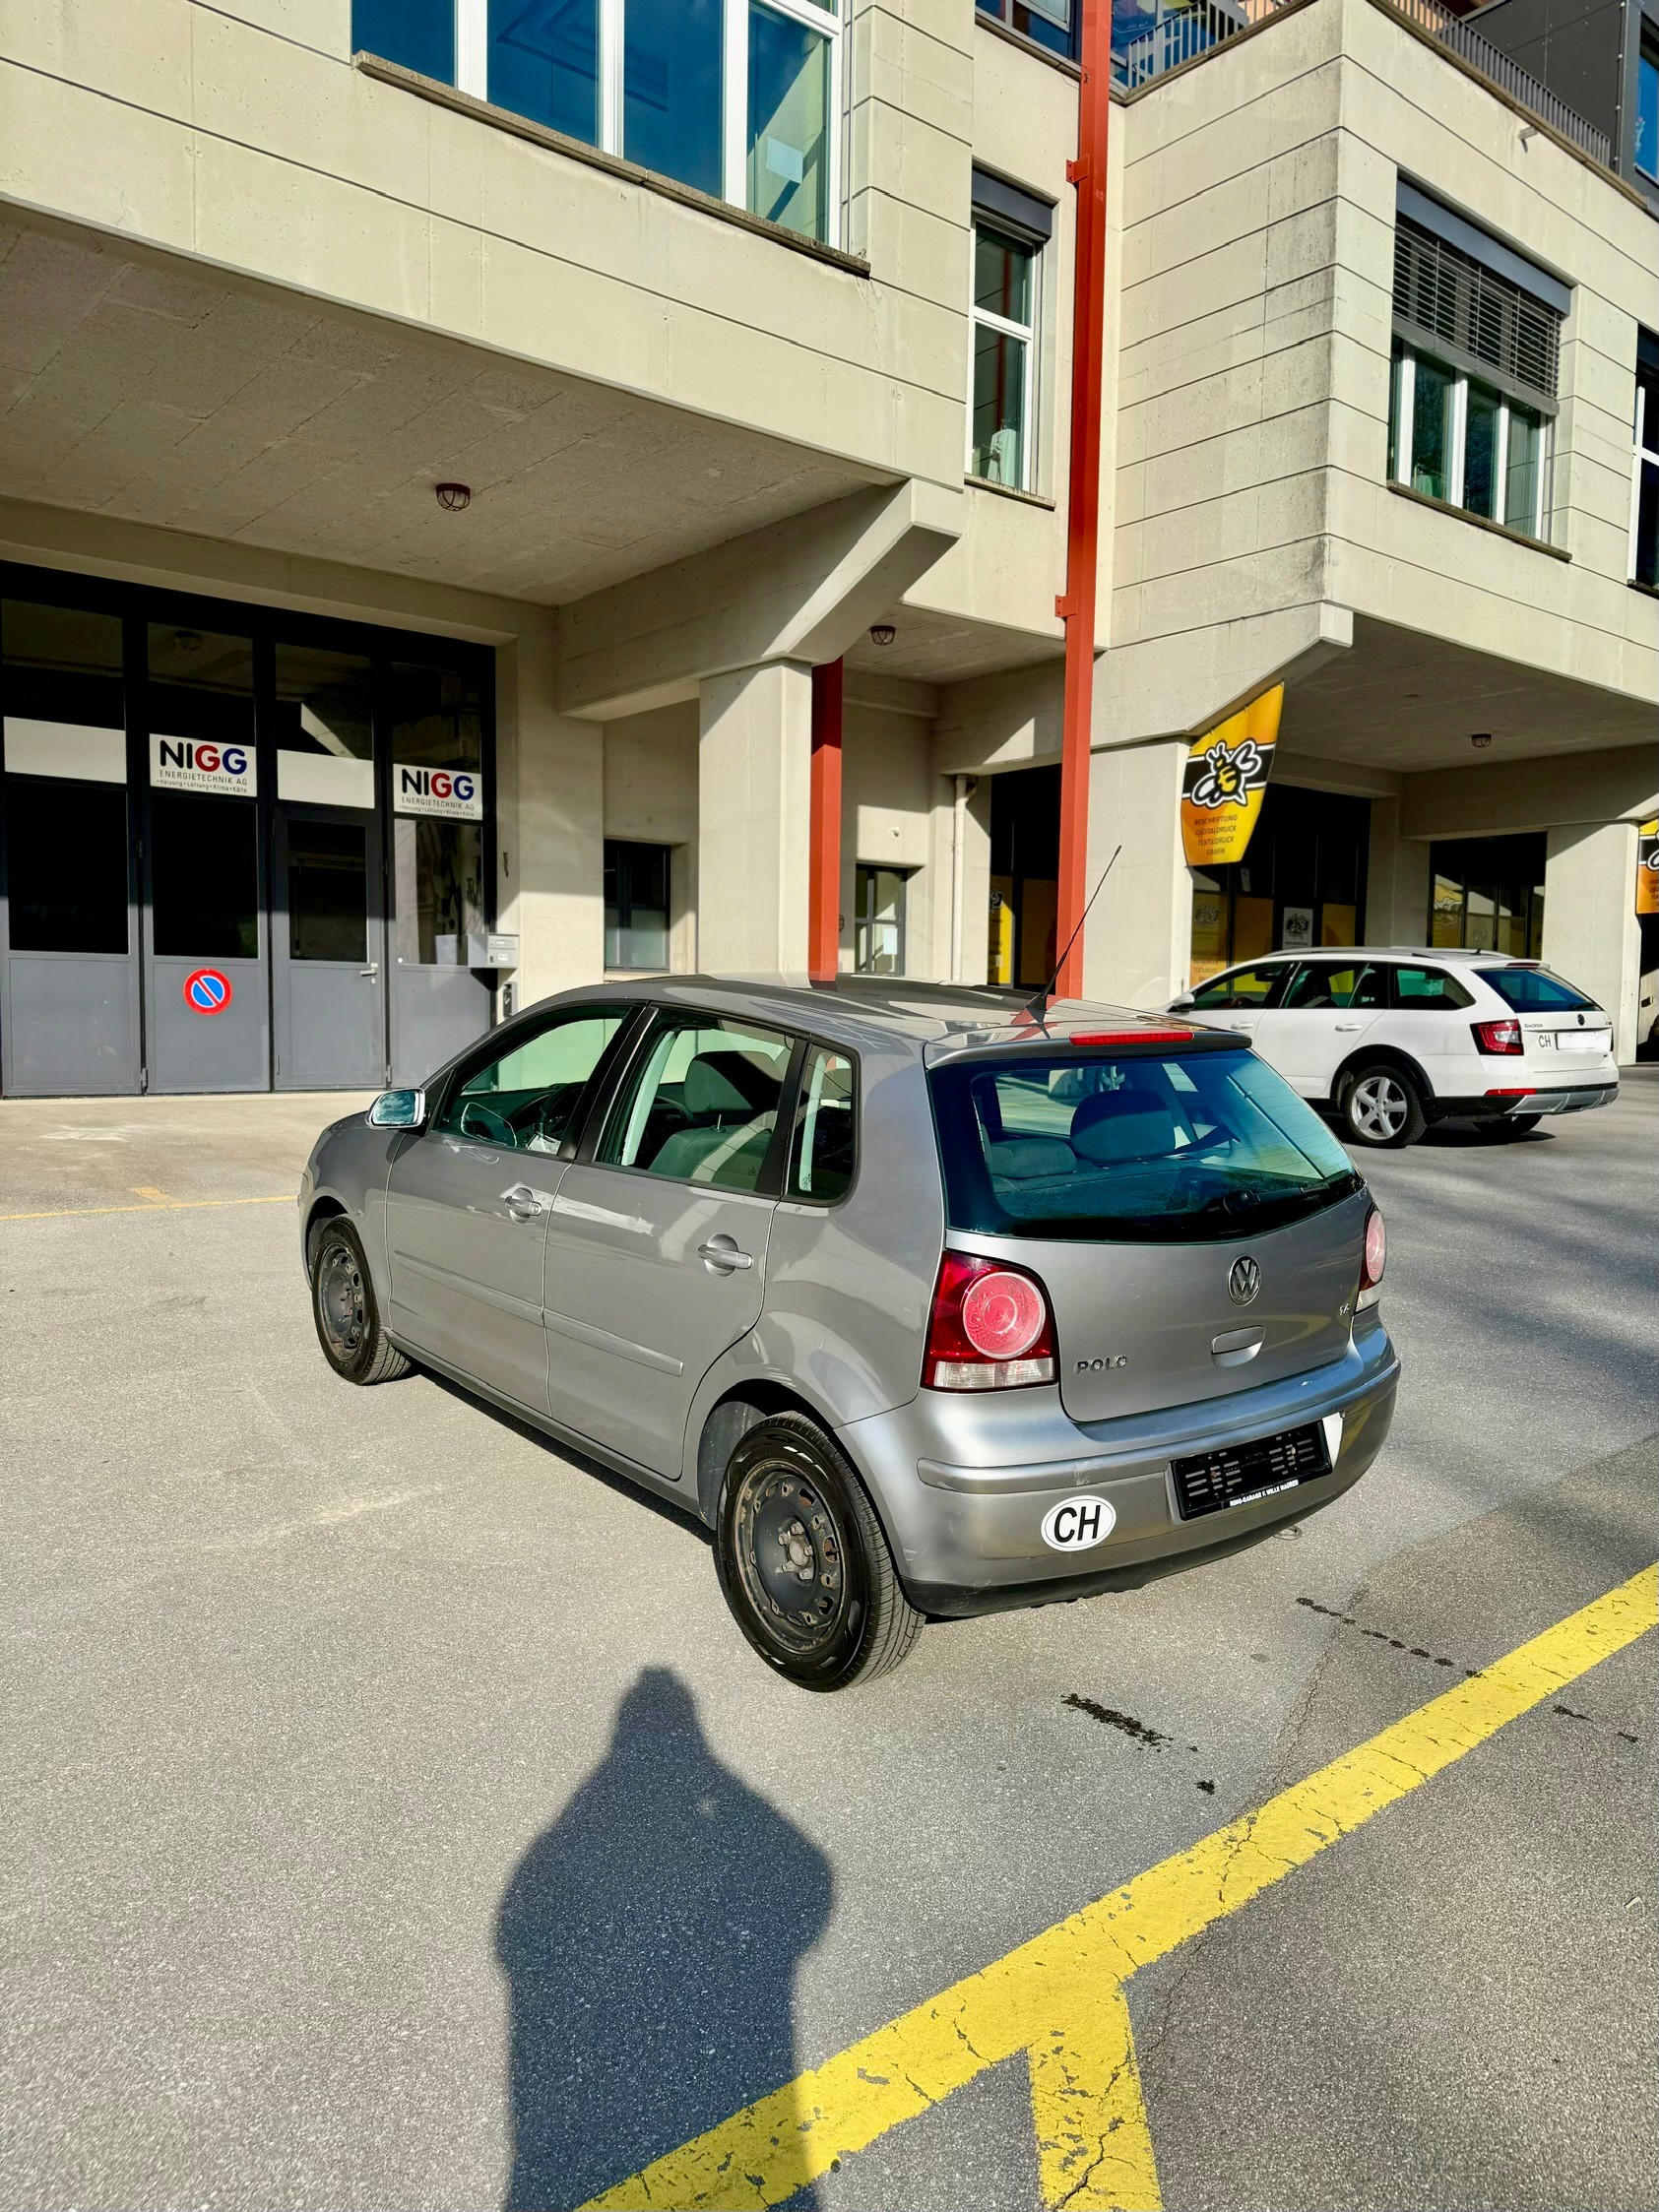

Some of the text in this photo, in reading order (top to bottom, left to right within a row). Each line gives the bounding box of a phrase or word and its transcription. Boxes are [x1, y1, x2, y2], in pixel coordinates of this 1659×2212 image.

[160, 739, 247, 775] NIGG
[160, 770, 233, 785] ENERGIETECHNIK
[160, 779, 183, 788] Heizung
[402, 768, 475, 800] NIGG
[401, 795, 463, 809] ENERGIETECHNIK
[1194, 814, 1239, 826] BESCHRIFTUNG
[1195, 825, 1238, 836] DIGITALDRUCK
[1198, 836, 1235, 847] TEXTILDRUCK
[1538, 1035, 1552, 1047] CH
[1074, 1355, 1128, 1374] POLO
[1053, 1504, 1101, 1543] CH
